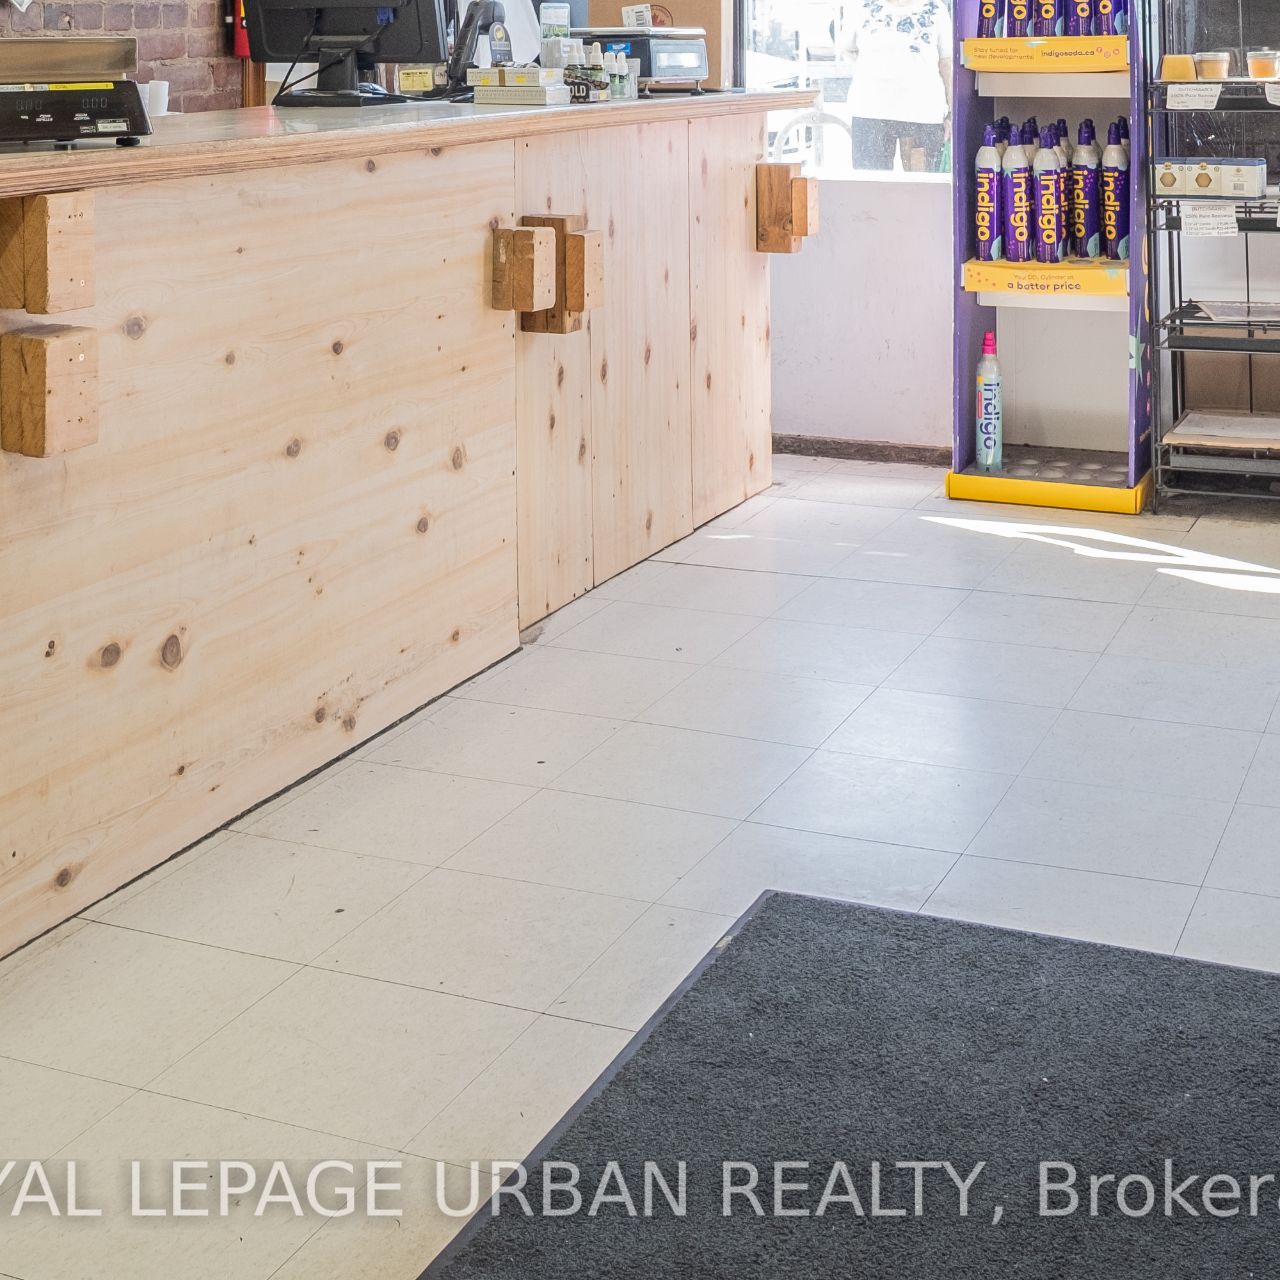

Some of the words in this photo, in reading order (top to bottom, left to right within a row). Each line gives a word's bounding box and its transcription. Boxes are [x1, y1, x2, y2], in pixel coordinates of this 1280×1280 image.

[1041, 50, 1095, 58] indigosoda.ca
[976, 172, 994, 241] indigo
[1010, 172, 1030, 241] indigo
[1038, 174, 1059, 244] indigo
[1073, 170, 1090, 238] indigo
[1103, 171, 1121, 240] indigo
[1053, 281, 1081, 292] price
[980, 383, 1000, 450] indigo
